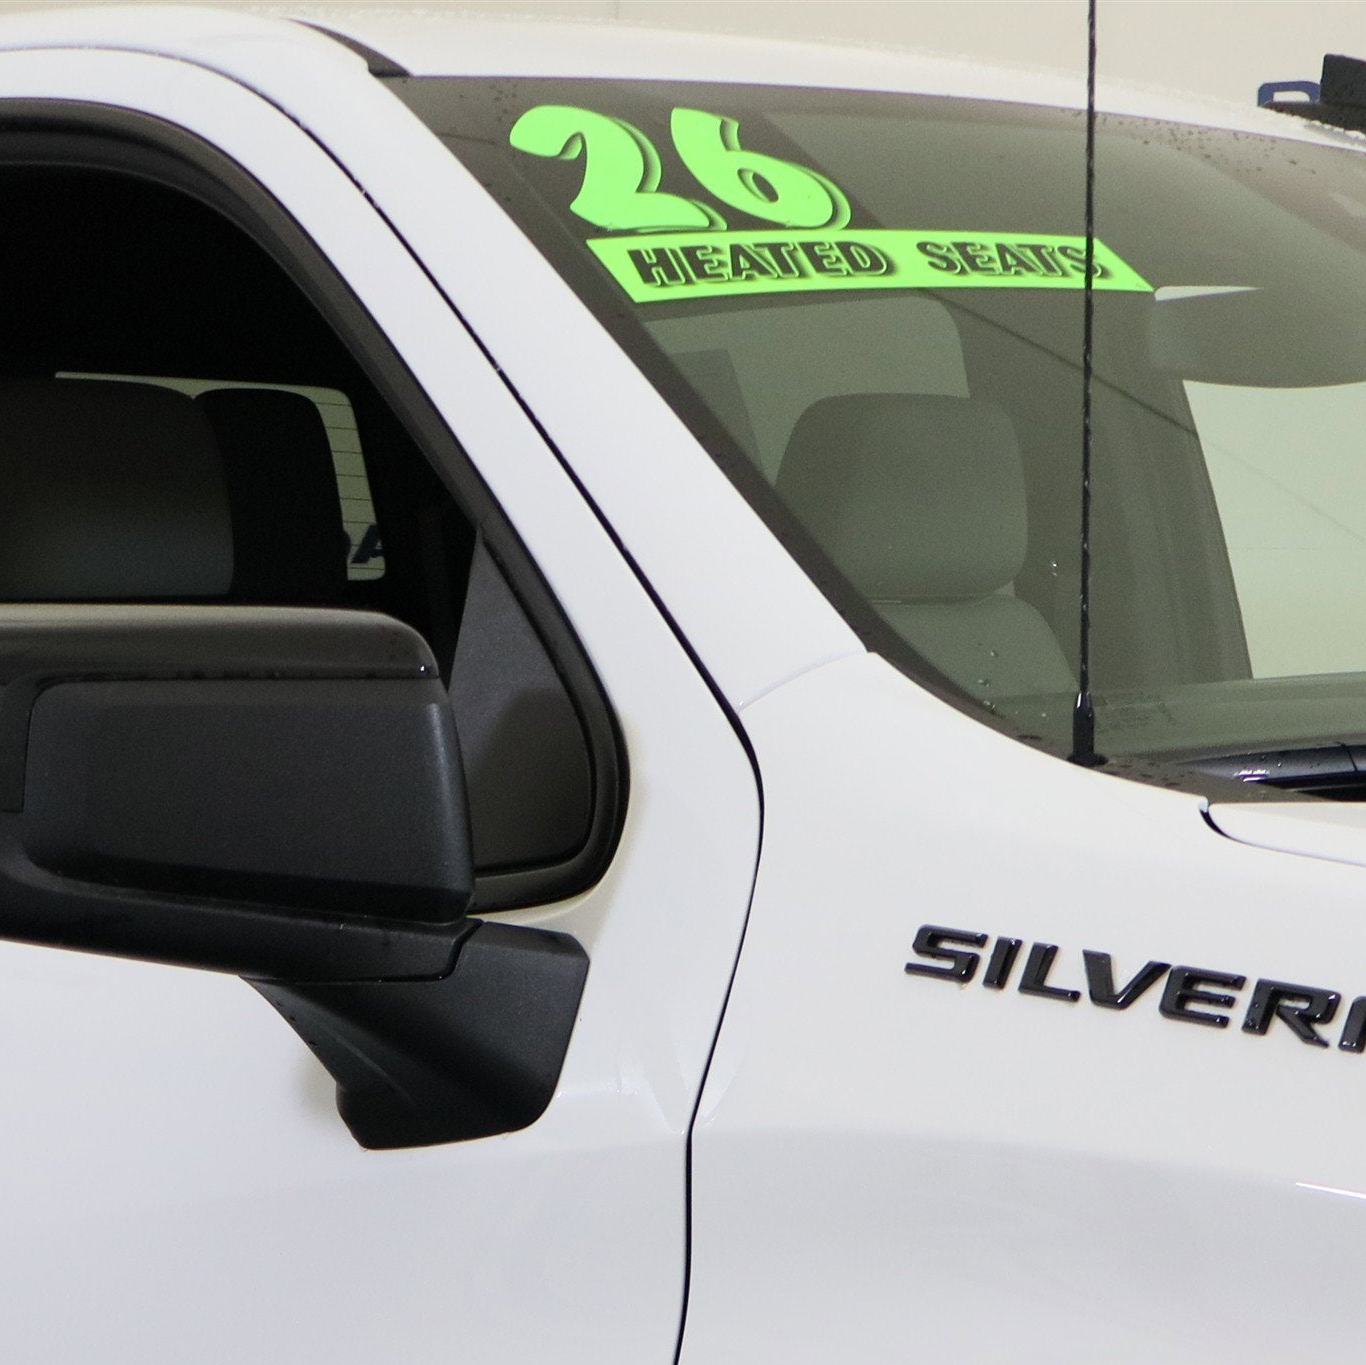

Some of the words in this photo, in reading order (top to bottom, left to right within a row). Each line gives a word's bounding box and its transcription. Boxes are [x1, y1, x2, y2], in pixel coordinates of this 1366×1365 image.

[509, 105, 851, 231] 26
[626, 240, 893, 288] HEATED
[917, 241, 1109, 279] SEATS
